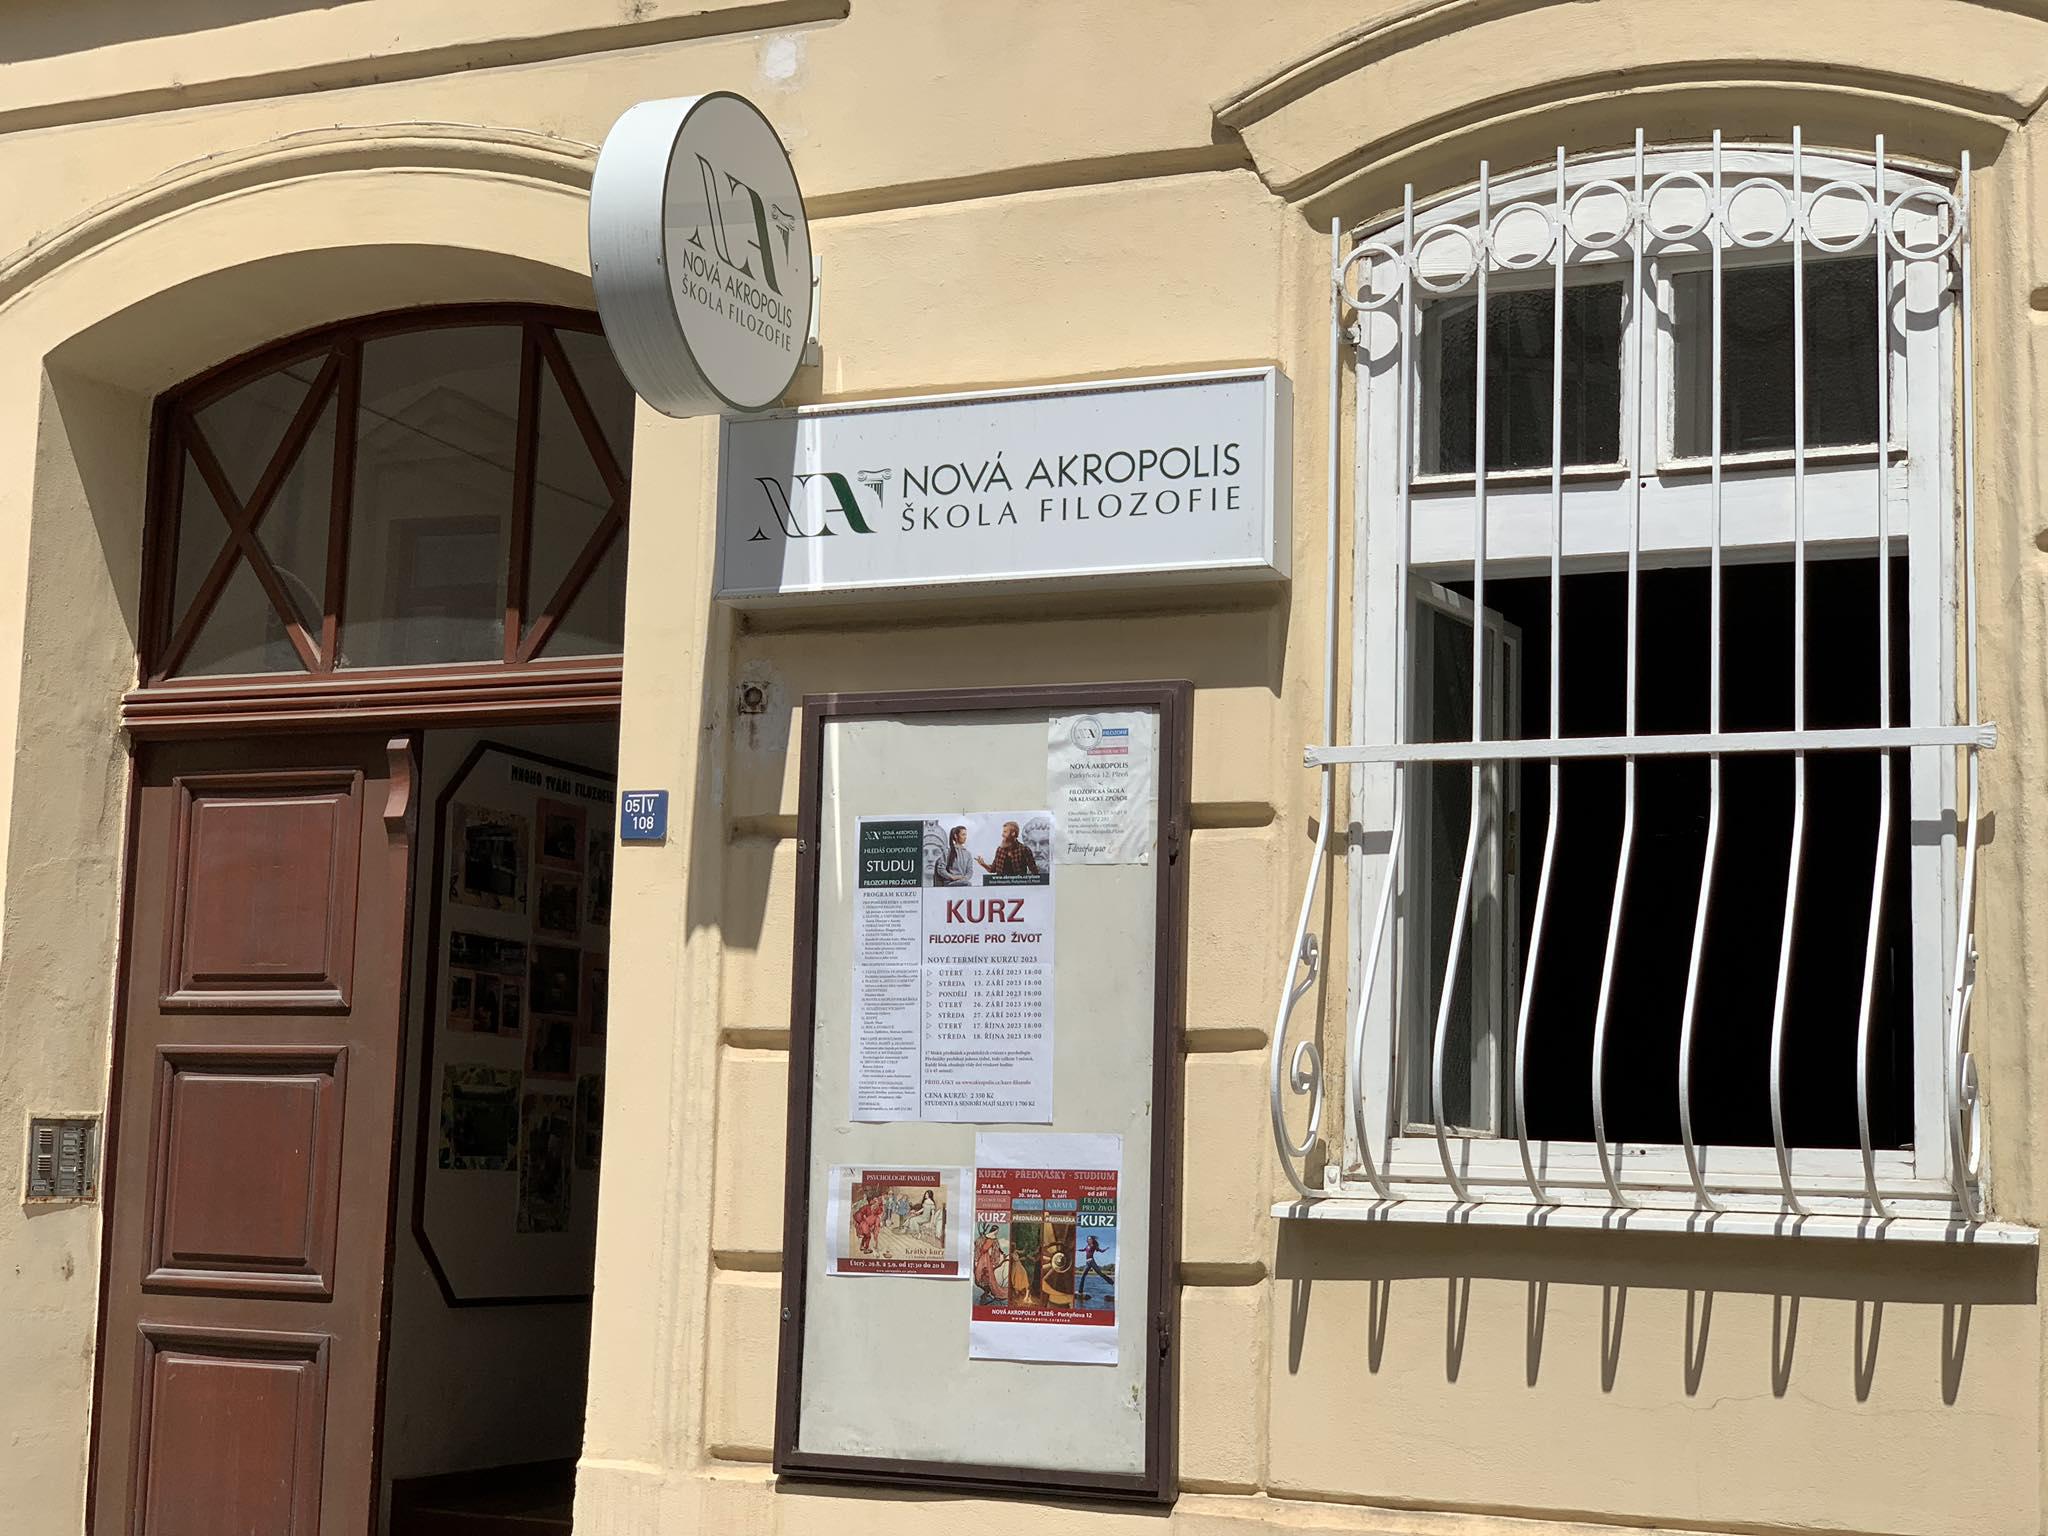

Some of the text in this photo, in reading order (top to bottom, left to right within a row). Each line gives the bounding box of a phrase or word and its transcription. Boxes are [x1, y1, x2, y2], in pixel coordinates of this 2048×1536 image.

[683, 249, 792, 328] NOVÁ AKROPOLIS
[682, 274, 792, 352] ŠKOLA FILOZOFIE
[903, 443, 1241, 497] NOVÁ AKROPOLIS
[902, 486, 1241, 531] ŠKOLA FILOZOFIE
[632, 817, 654, 830] 108
[867, 860, 914, 872] STUDUJ
[946, 899, 1025, 923] KURZ
[929, 932, 1042, 944] FILOZOFIE PRO ŽIVOT
[907, 1174, 935, 1182] POHÁDEK
[978, 1170, 1115, 1180] KURZY PŘEDNÁŠKY STUDIUM
[977, 1212, 1006, 1222] KURZ
[1080, 1216, 1114, 1226] KURZ
